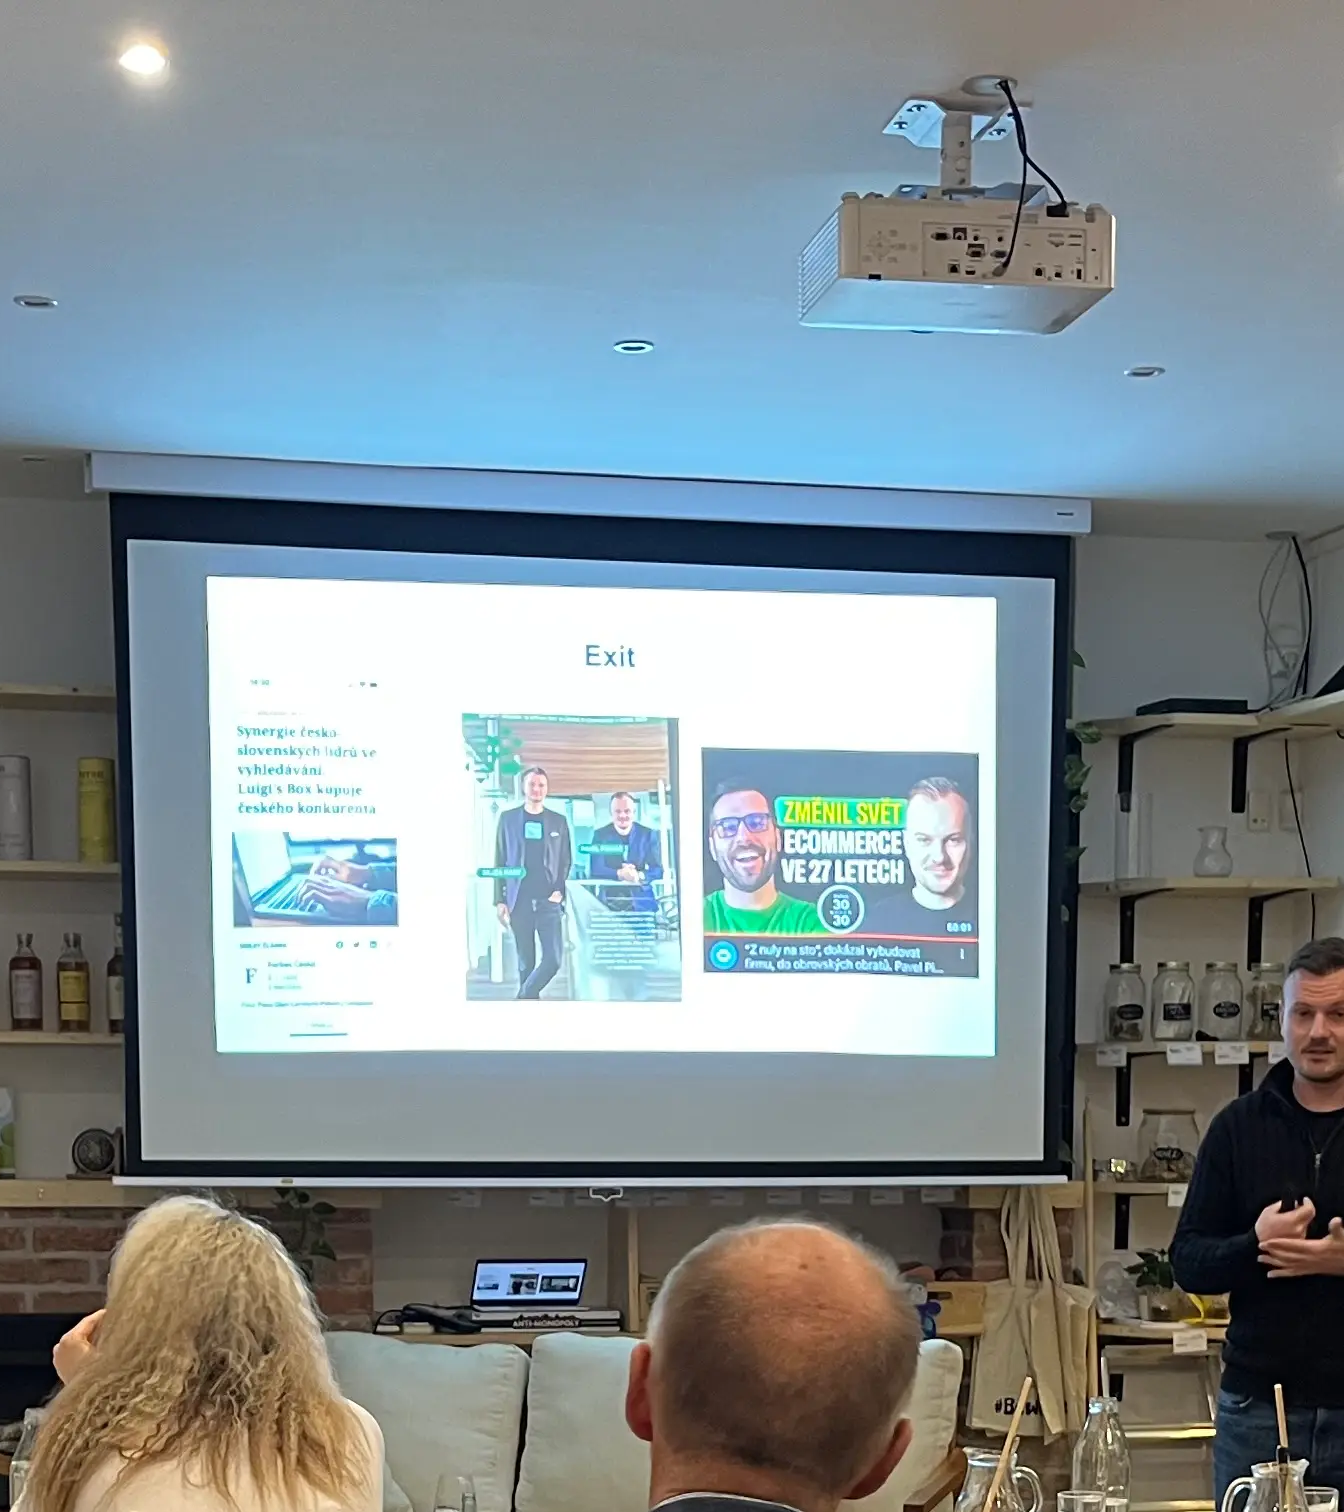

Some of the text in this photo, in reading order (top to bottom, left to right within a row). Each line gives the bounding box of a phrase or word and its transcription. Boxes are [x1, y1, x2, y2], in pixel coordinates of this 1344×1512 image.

[585, 644, 636, 667] Exit
[236, 725, 296, 739] Synergie
[362, 748, 377, 758] ve
[287, 783, 312, 795] Box
[316, 784, 363, 798] kupuje
[238, 801, 376, 814] českého konkurenta
[784, 797, 901, 825] ZMĚNIL SVĚT
[784, 829, 903, 855] ECOMMERCE
[781, 858, 905, 885] VE 27 LETECH
[832, 898, 851, 911] 30
[832, 915, 851, 927] 30
[759, 944, 782, 958] nuly
[784, 946, 797, 956] na
[777, 959, 791, 970] do
[513, 1319, 580, 1328] ANTI-MONOPOLY
